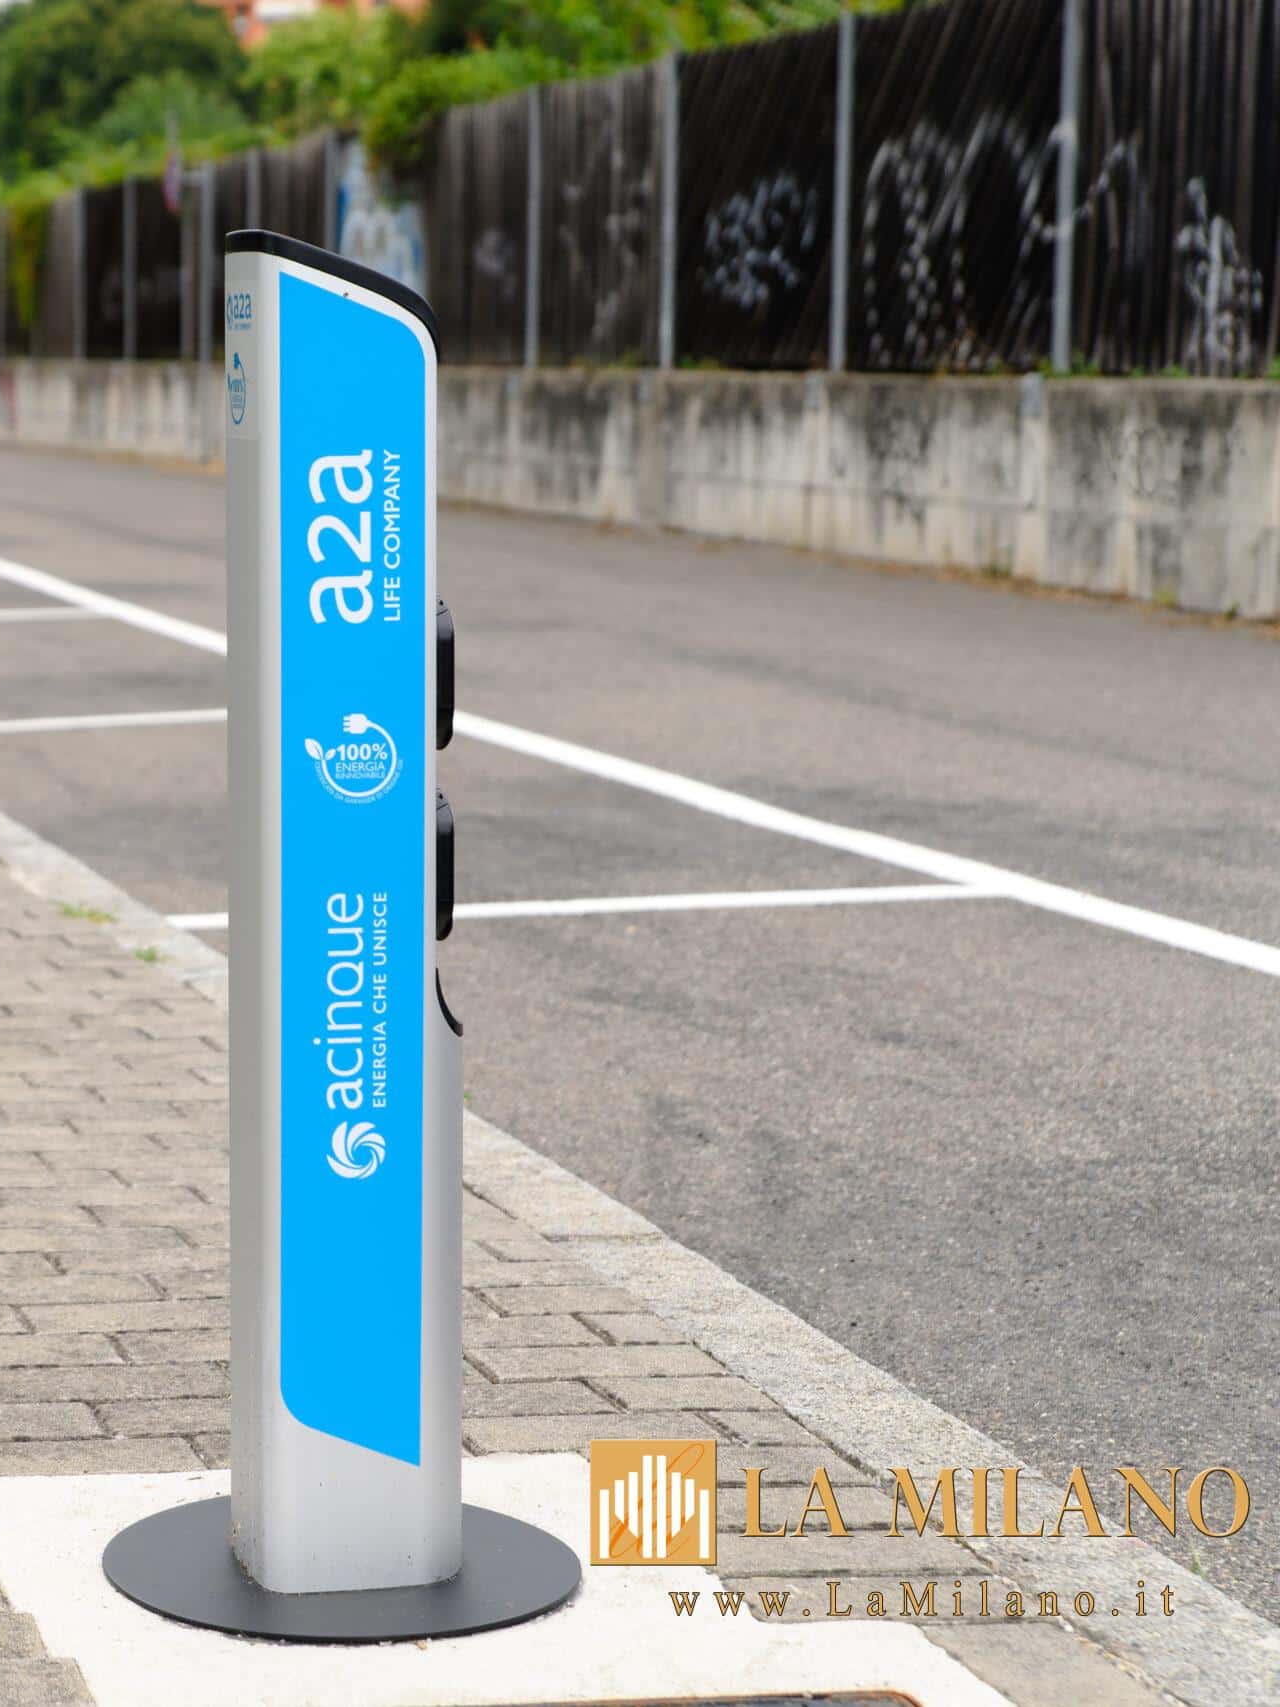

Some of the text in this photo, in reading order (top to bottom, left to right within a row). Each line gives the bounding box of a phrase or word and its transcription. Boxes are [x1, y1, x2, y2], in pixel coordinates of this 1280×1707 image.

[306, 449, 374, 625] a2a
[383, 449, 401, 622] LIFE COMPANY
[335, 761, 386, 772] ENERGIA
[336, 743, 388, 761] 100%
[312, 892, 365, 1110] acinque
[372, 892, 387, 1108] ENERGIA CHE UNISCE
